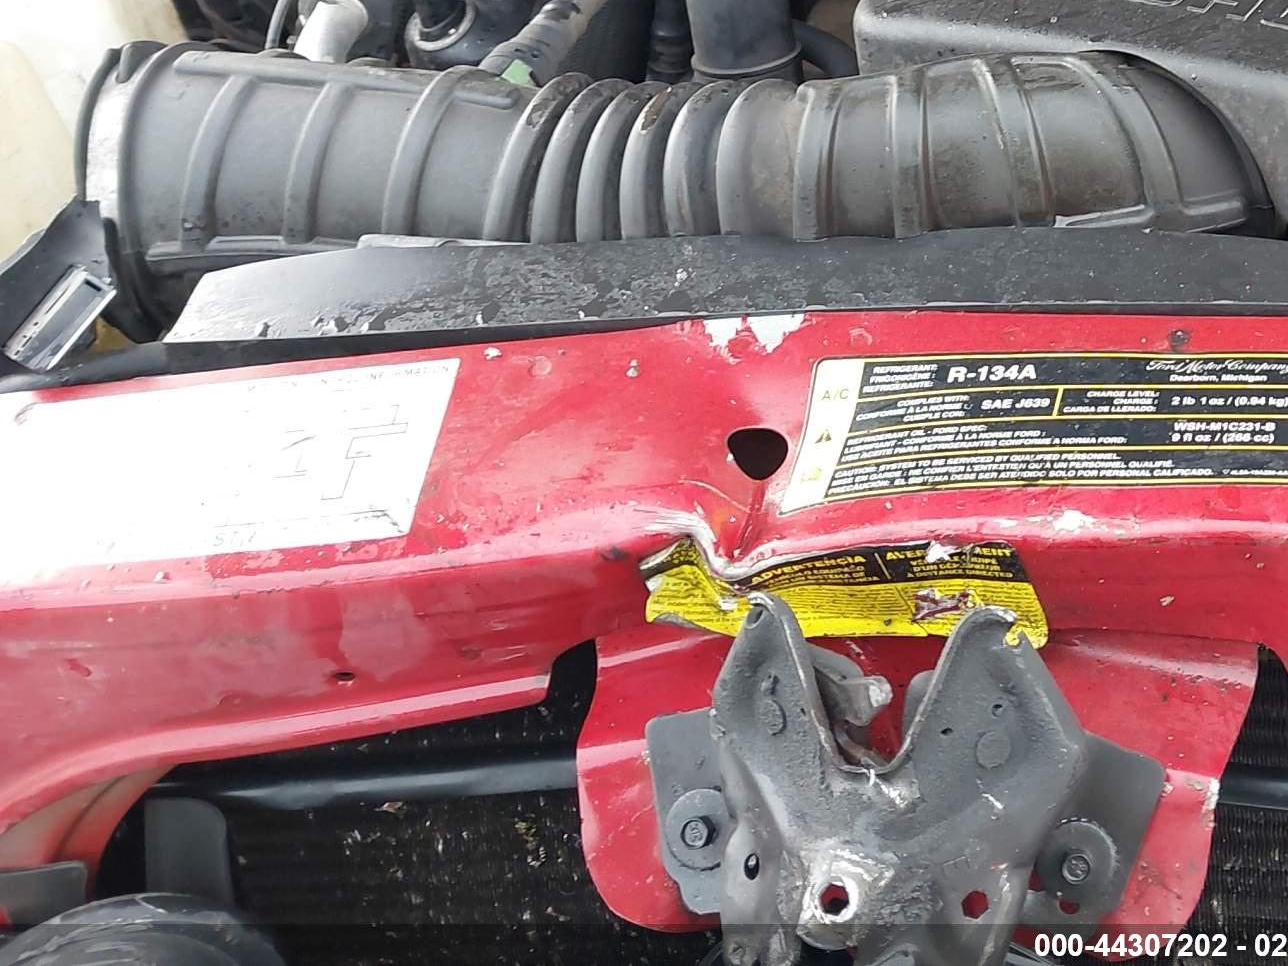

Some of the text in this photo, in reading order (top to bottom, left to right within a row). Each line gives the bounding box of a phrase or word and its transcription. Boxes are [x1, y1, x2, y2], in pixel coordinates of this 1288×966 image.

[873, 364, 938, 374] REFRIGERANT:
[947, 364, 1037, 383] R-134A
[1169, 374, 1268, 383] Dearborn, Michigan
[862, 380, 935, 394] REFRIGERANTE:
[821, 388, 849, 401] A/C
[1087, 390, 1160, 398] CHARGE LEVEL:
[897, 395, 970, 408] COMPLIES WITH:
[981, 398, 1051, 410] SAE J639
[1171, 396, 1180, 406] 2
[1182, 396, 1196, 406] lb
[1200, 396, 1207, 405] 1
[1208, 398, 1225, 406] oz
[1234, 396, 1266, 407] (0.94
[856, 408, 906, 421] CONFORME
[916, 404, 928, 413] LA
[1110, 405, 1157, 413] LLENADO:
[903, 412, 941, 423] CUMPLE
[902, 434, 955, 446] CONFORME
[964, 432, 978, 440] LA
[979, 431, 1013, 440] NORME
[910, 429, 926, 437] OIL
[932, 427, 959, 435] FORD
[1171, 433, 1179, 442] 9
[1253, 434, 1275, 443] cc)
[893, 445, 919, 455] PARA
[920, 440, 997, 451] REFRIGERANTES
[998, 437, 1052, 446] CONFORME
[1061, 436, 1096, 445] NORMA
[1098, 436, 1128, 444] FORD:
[878, 461, 916, 472] SYSTEM
[918, 459, 931, 467] TO
[931, 458, 946, 466] BE
[946, 455, 994, 465] SERVICED
[994, 455, 1009, 463] BY
[1010, 453, 1060, 462] QUALIFIED
[854, 474, 869, 483] EN
[908, 468, 923, 477] NE
[1053, 461, 1067, 469] UN
[1068, 460, 1127, 469] PERSONNEL
[893, 477, 907, 486] EL
[907, 474, 949, 485] SISTEMA
[949, 472, 976, 482] DEBE
[977, 471, 997, 480] SER
[1048, 470, 1074, 478] SOLO
[1075, 469, 1099, 478] POR
[1099, 469, 1151, 477] PERSONAL
[751, 554, 866, 585] ADVERTENCIA
